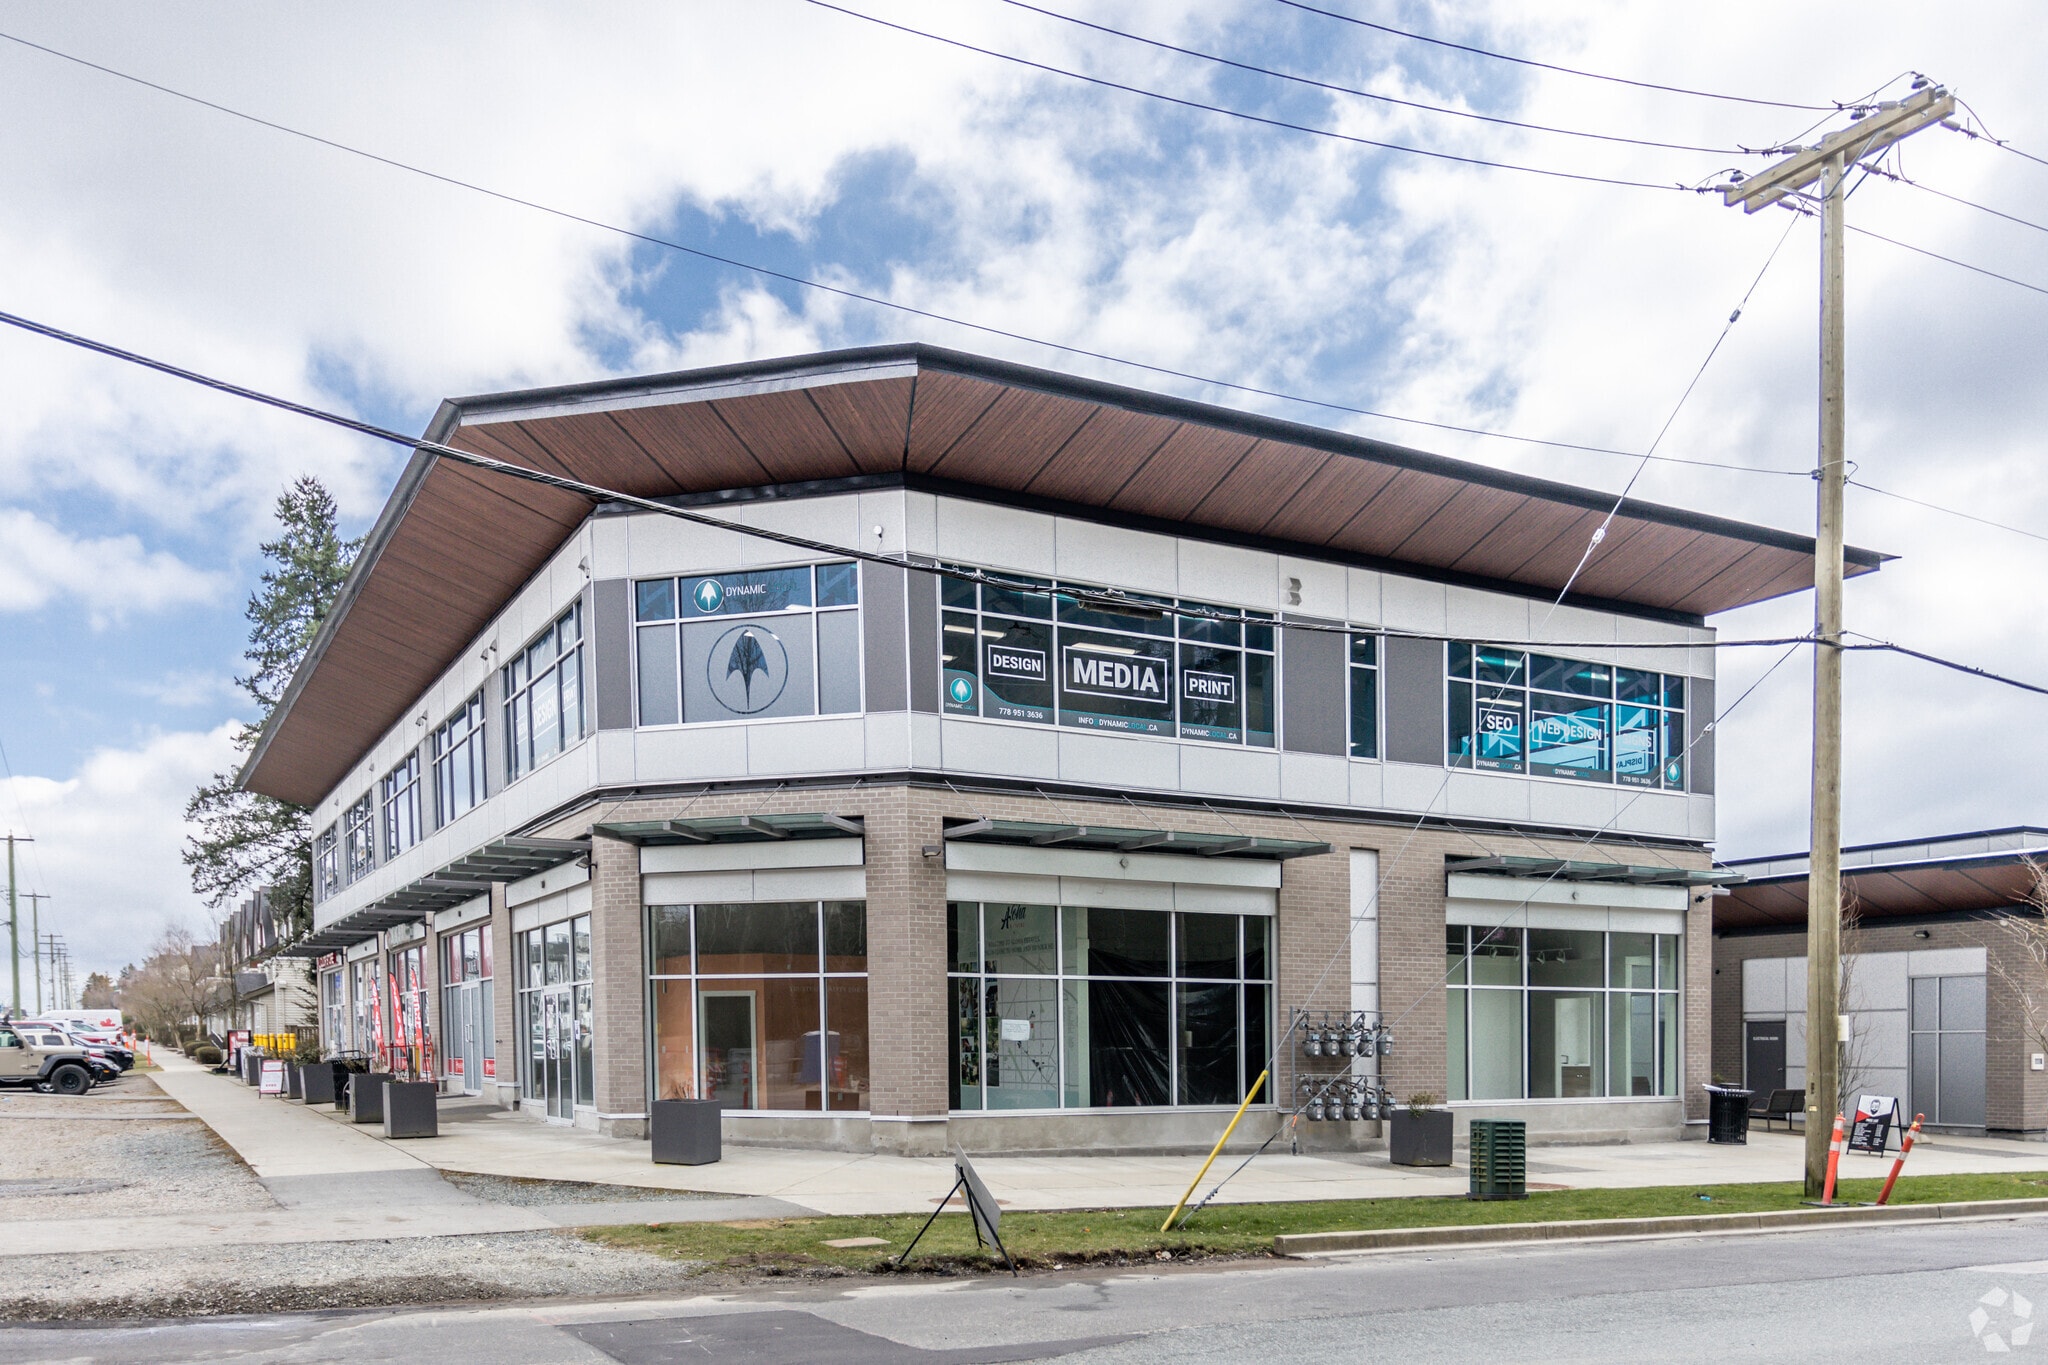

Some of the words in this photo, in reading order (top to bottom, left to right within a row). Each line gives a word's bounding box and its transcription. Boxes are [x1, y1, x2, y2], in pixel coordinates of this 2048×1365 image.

[726, 583, 766, 597] DYNAMIC
[992, 653, 1041, 673] DESIGN
[1072, 657, 1160, 693] MEDIA
[1188, 677, 1231, 696] PRINT
[998, 707, 1012, 716] 778
[1012, 708, 1025, 717] 951
[1026, 710, 1044, 719] 3636
[1486, 714, 1513, 732] SEO
[1538, 720, 1561, 736] WEB
[1563, 725, 1602, 741] DESIGN
[1623, 733, 1652, 748] SIGNS
